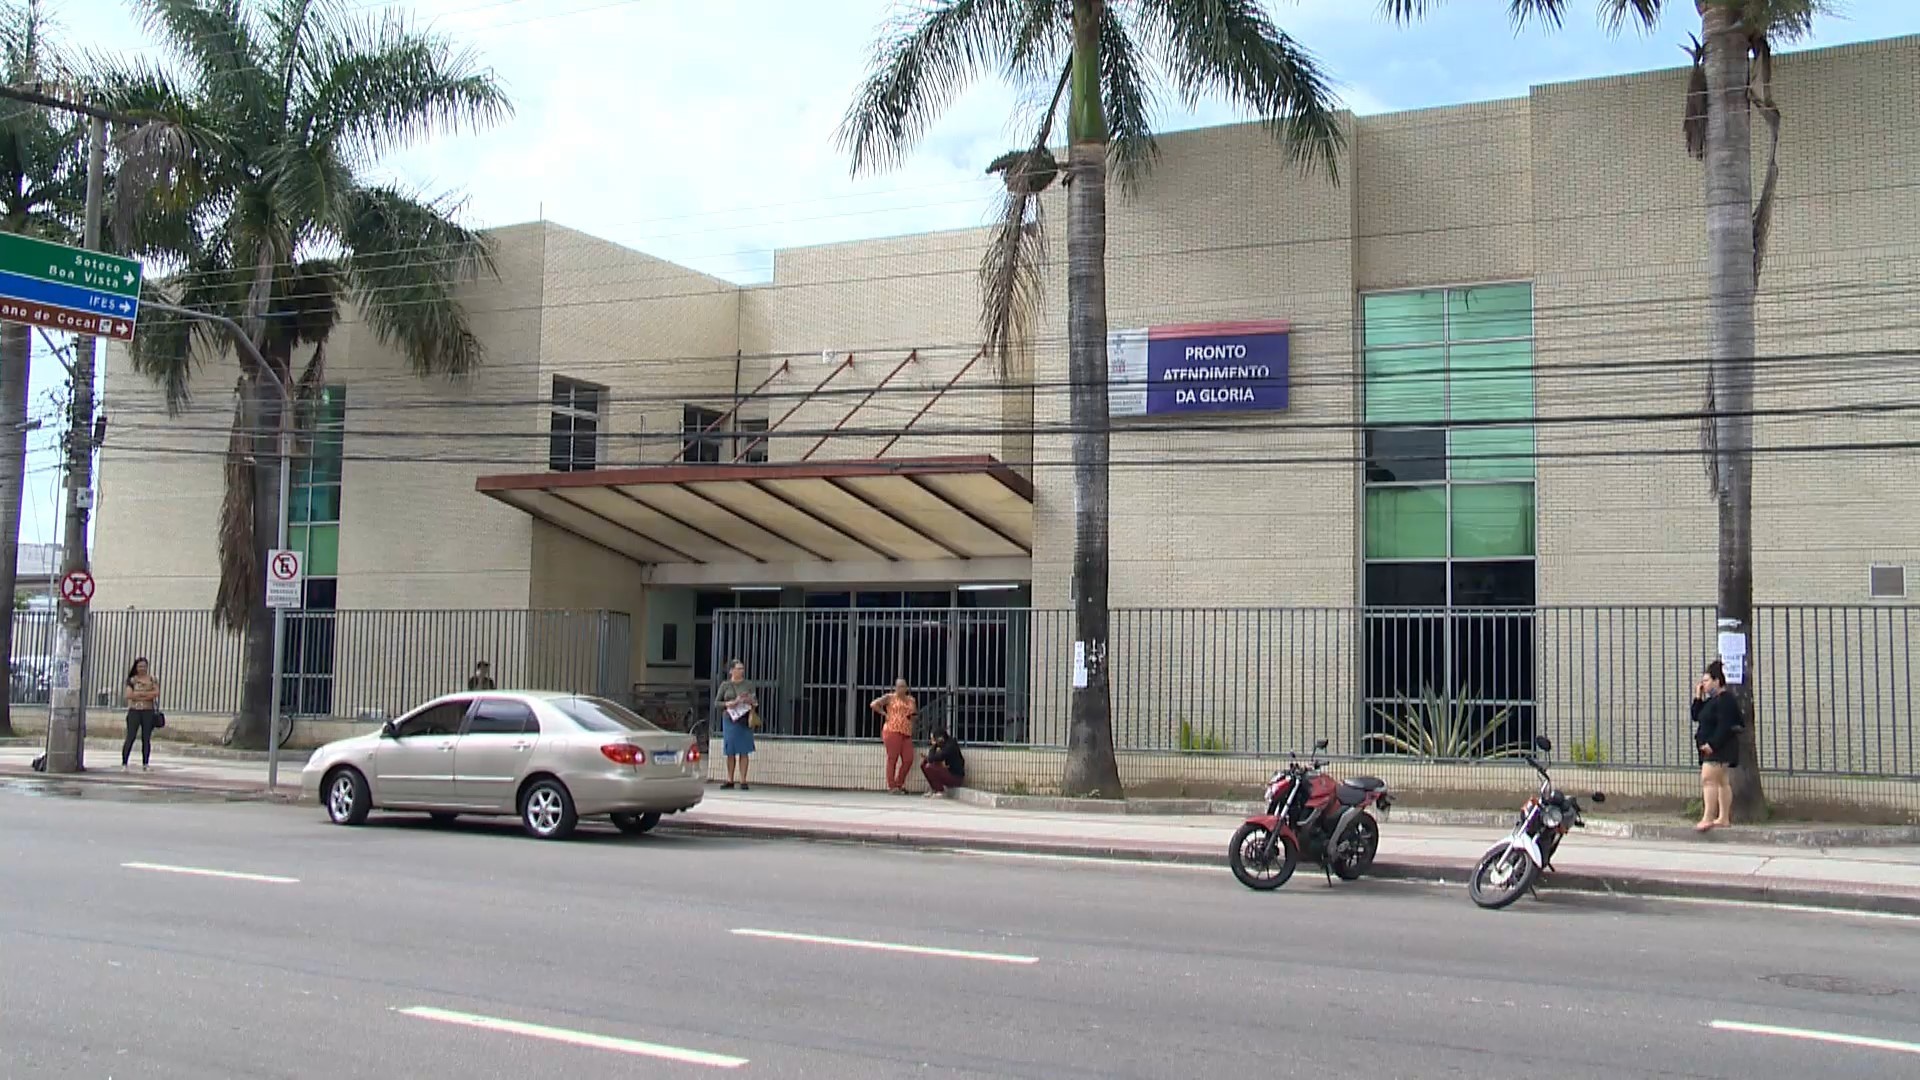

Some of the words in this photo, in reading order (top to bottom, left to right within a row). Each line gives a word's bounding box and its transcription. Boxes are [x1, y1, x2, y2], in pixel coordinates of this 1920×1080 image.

[75, 255, 120, 273] Soteco
[48, 265, 75, 280] Boa
[84, 272, 119, 288] Vista
[89, 295, 115, 310] IFES
[34, 309, 50, 321] de
[57, 313, 96, 328] Cocal
[1185, 344, 1247, 361] PRONTO
[1163, 364, 1270, 381] ATENDIMENTO
[1175, 389, 1196, 404] DA
